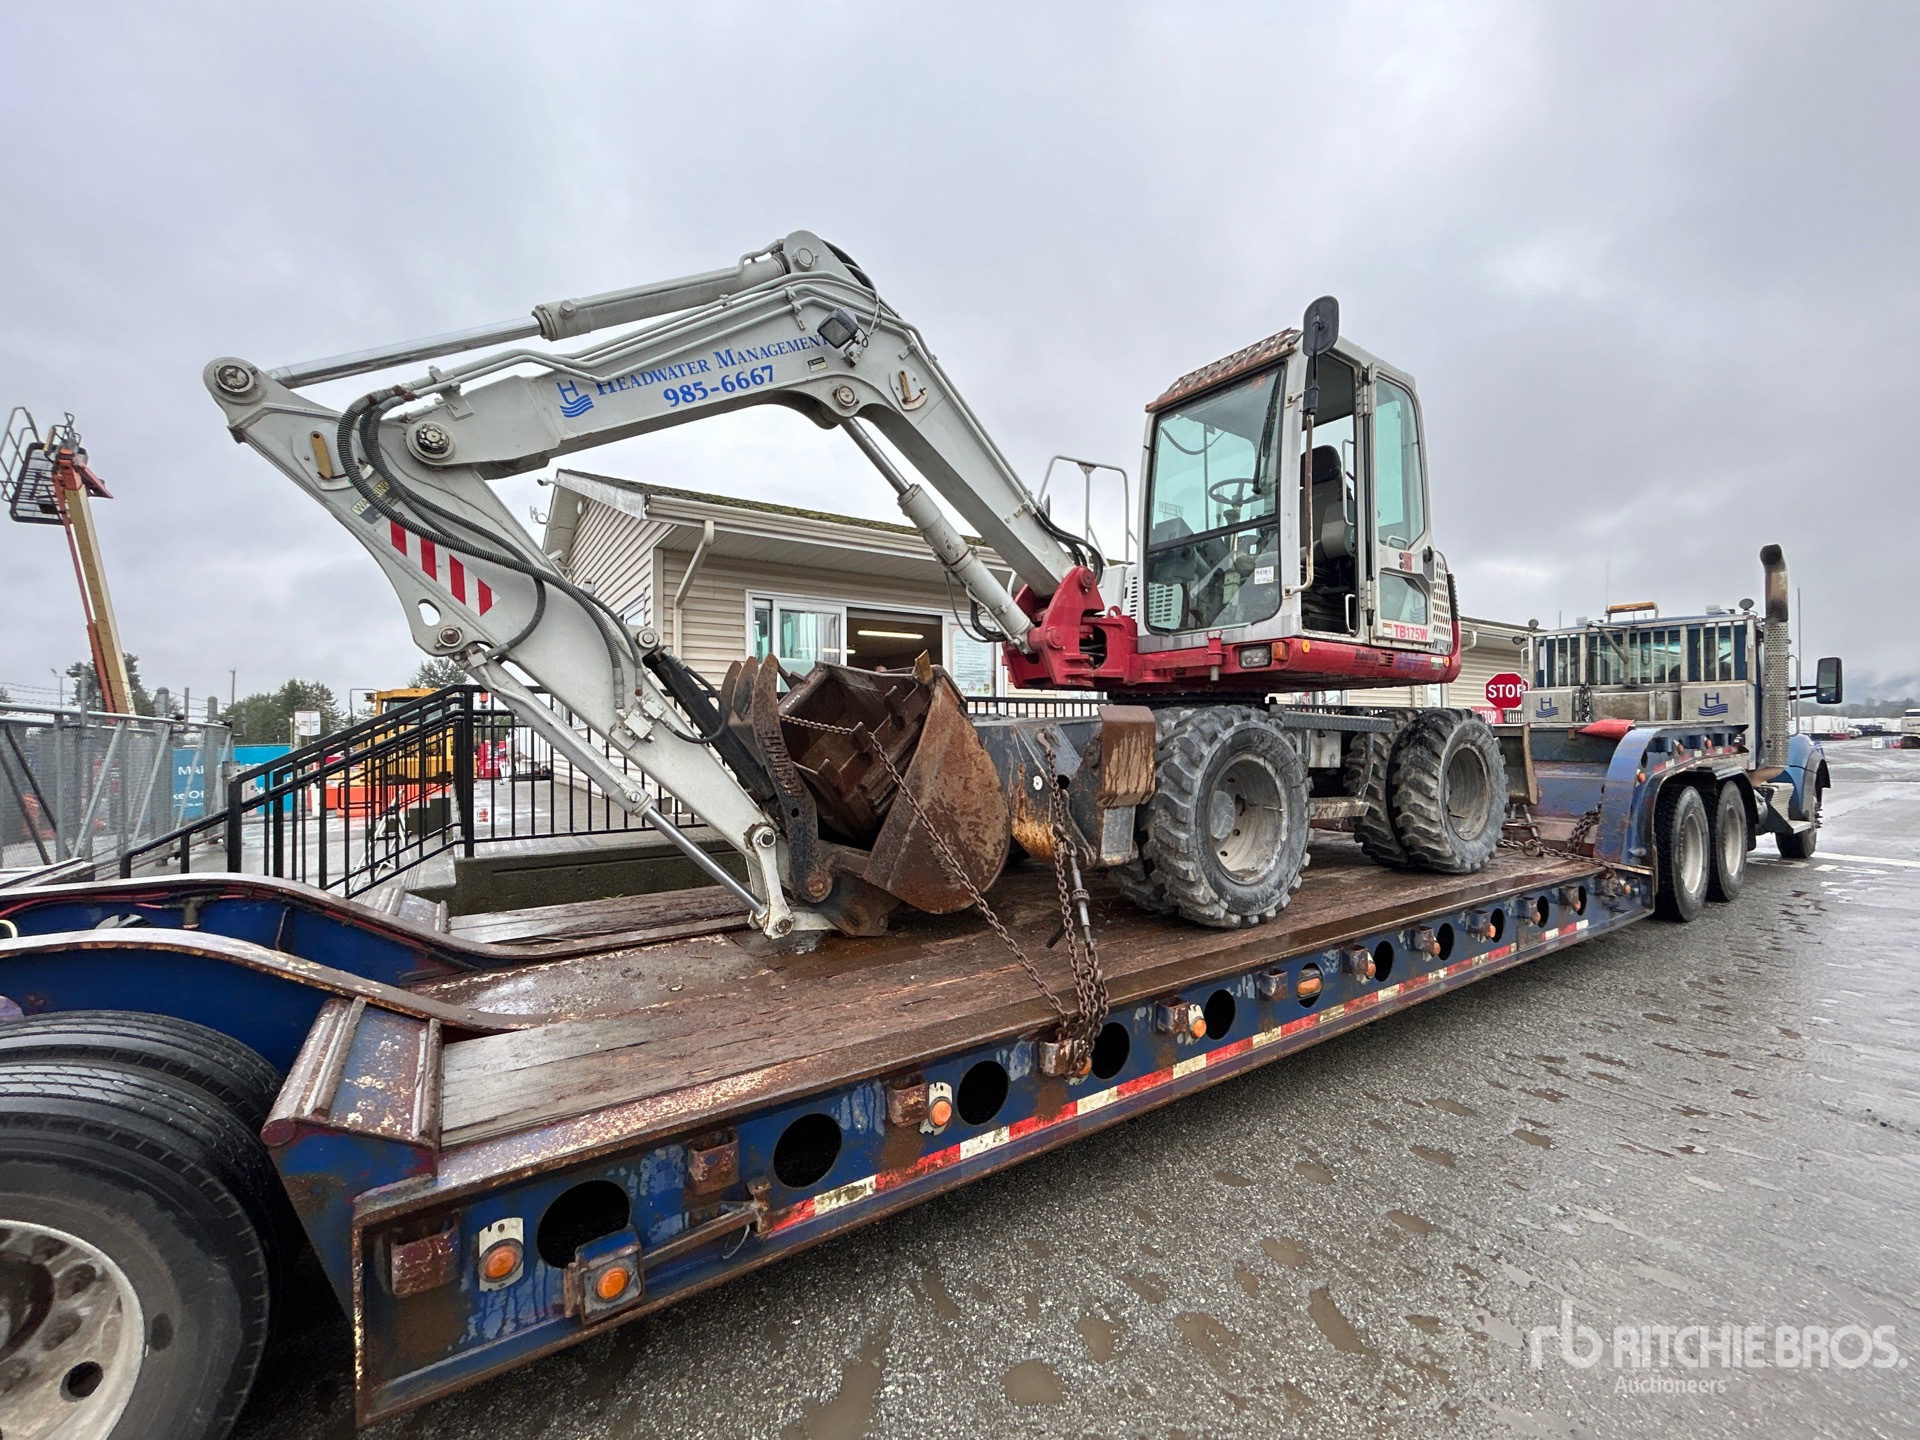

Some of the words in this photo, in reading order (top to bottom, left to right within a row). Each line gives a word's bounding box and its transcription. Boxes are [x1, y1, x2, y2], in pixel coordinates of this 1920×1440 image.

[595, 359, 711, 396] HEADWATER
[663, 364, 774, 407] 985-6667
[1393, 624, 1428, 641] TB175W
[1487, 684, 1527, 699] STOP
